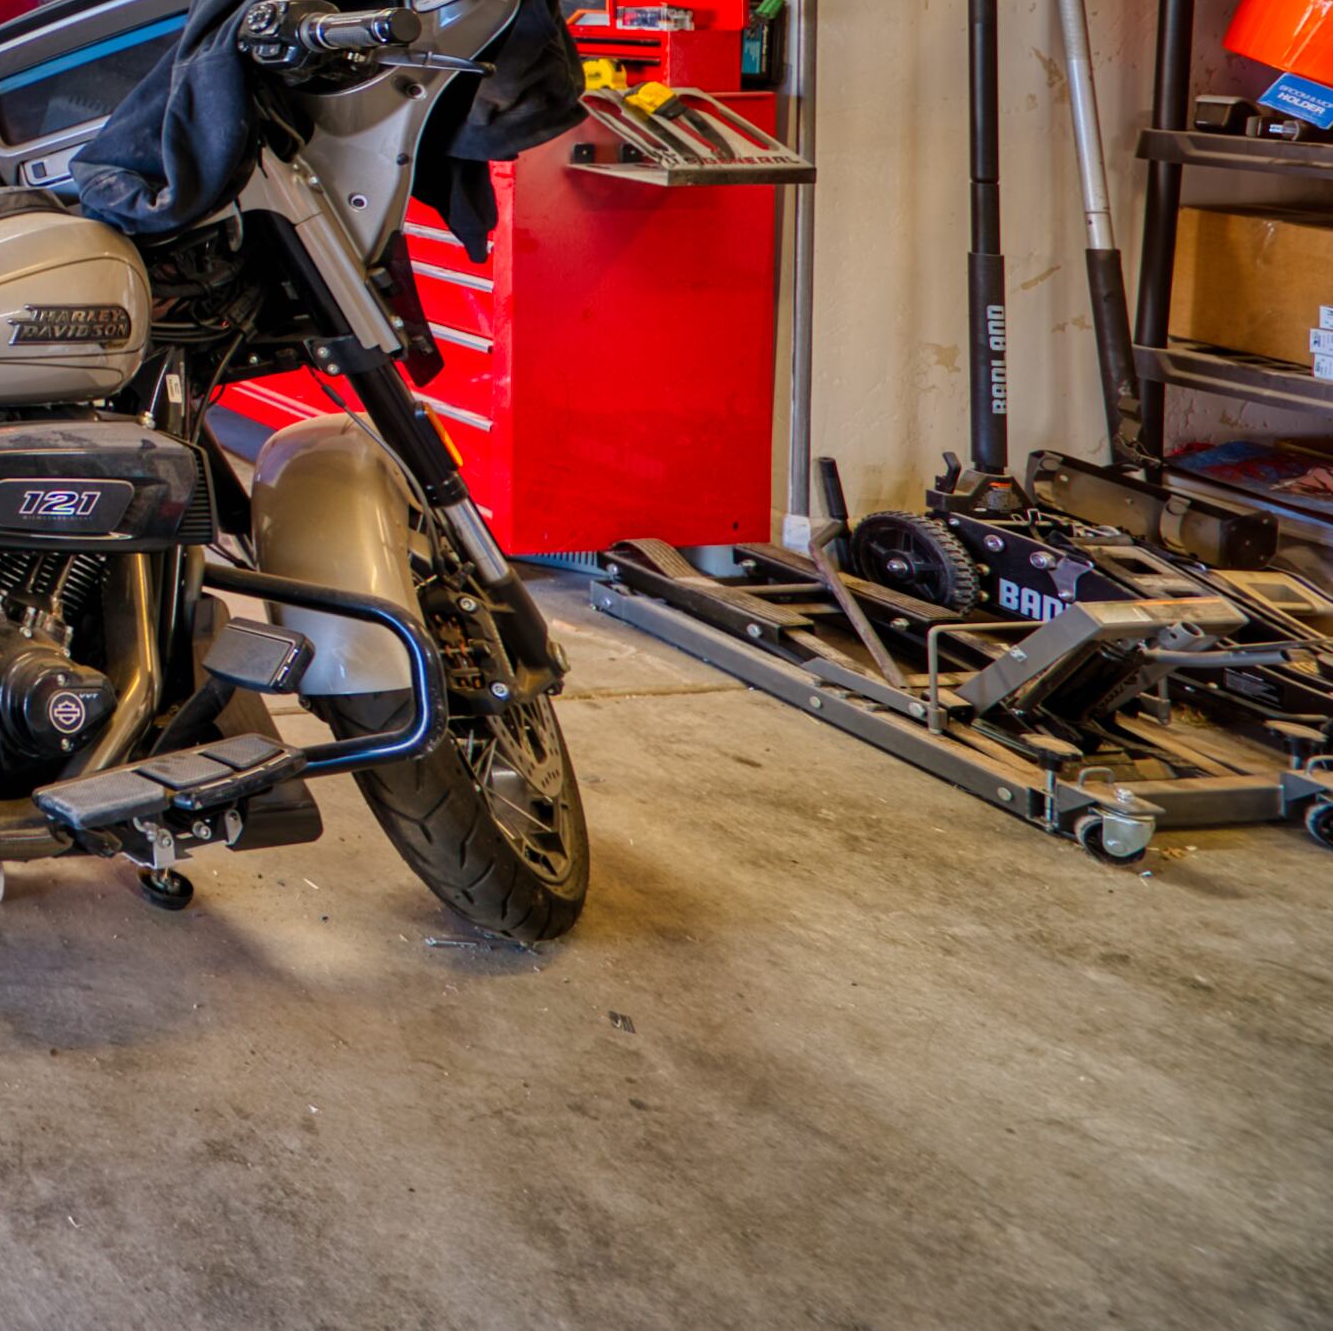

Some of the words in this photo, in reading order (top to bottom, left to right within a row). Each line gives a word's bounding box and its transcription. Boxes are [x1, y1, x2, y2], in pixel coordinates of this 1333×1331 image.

[1277, 92, 1326, 115] HOLDER
[20, 324, 129, 338] DAVIDSON
[986, 304, 1006, 415] BADLAND
[19, 490, 101, 516] 121
[999, 577, 1068, 623] BAD
